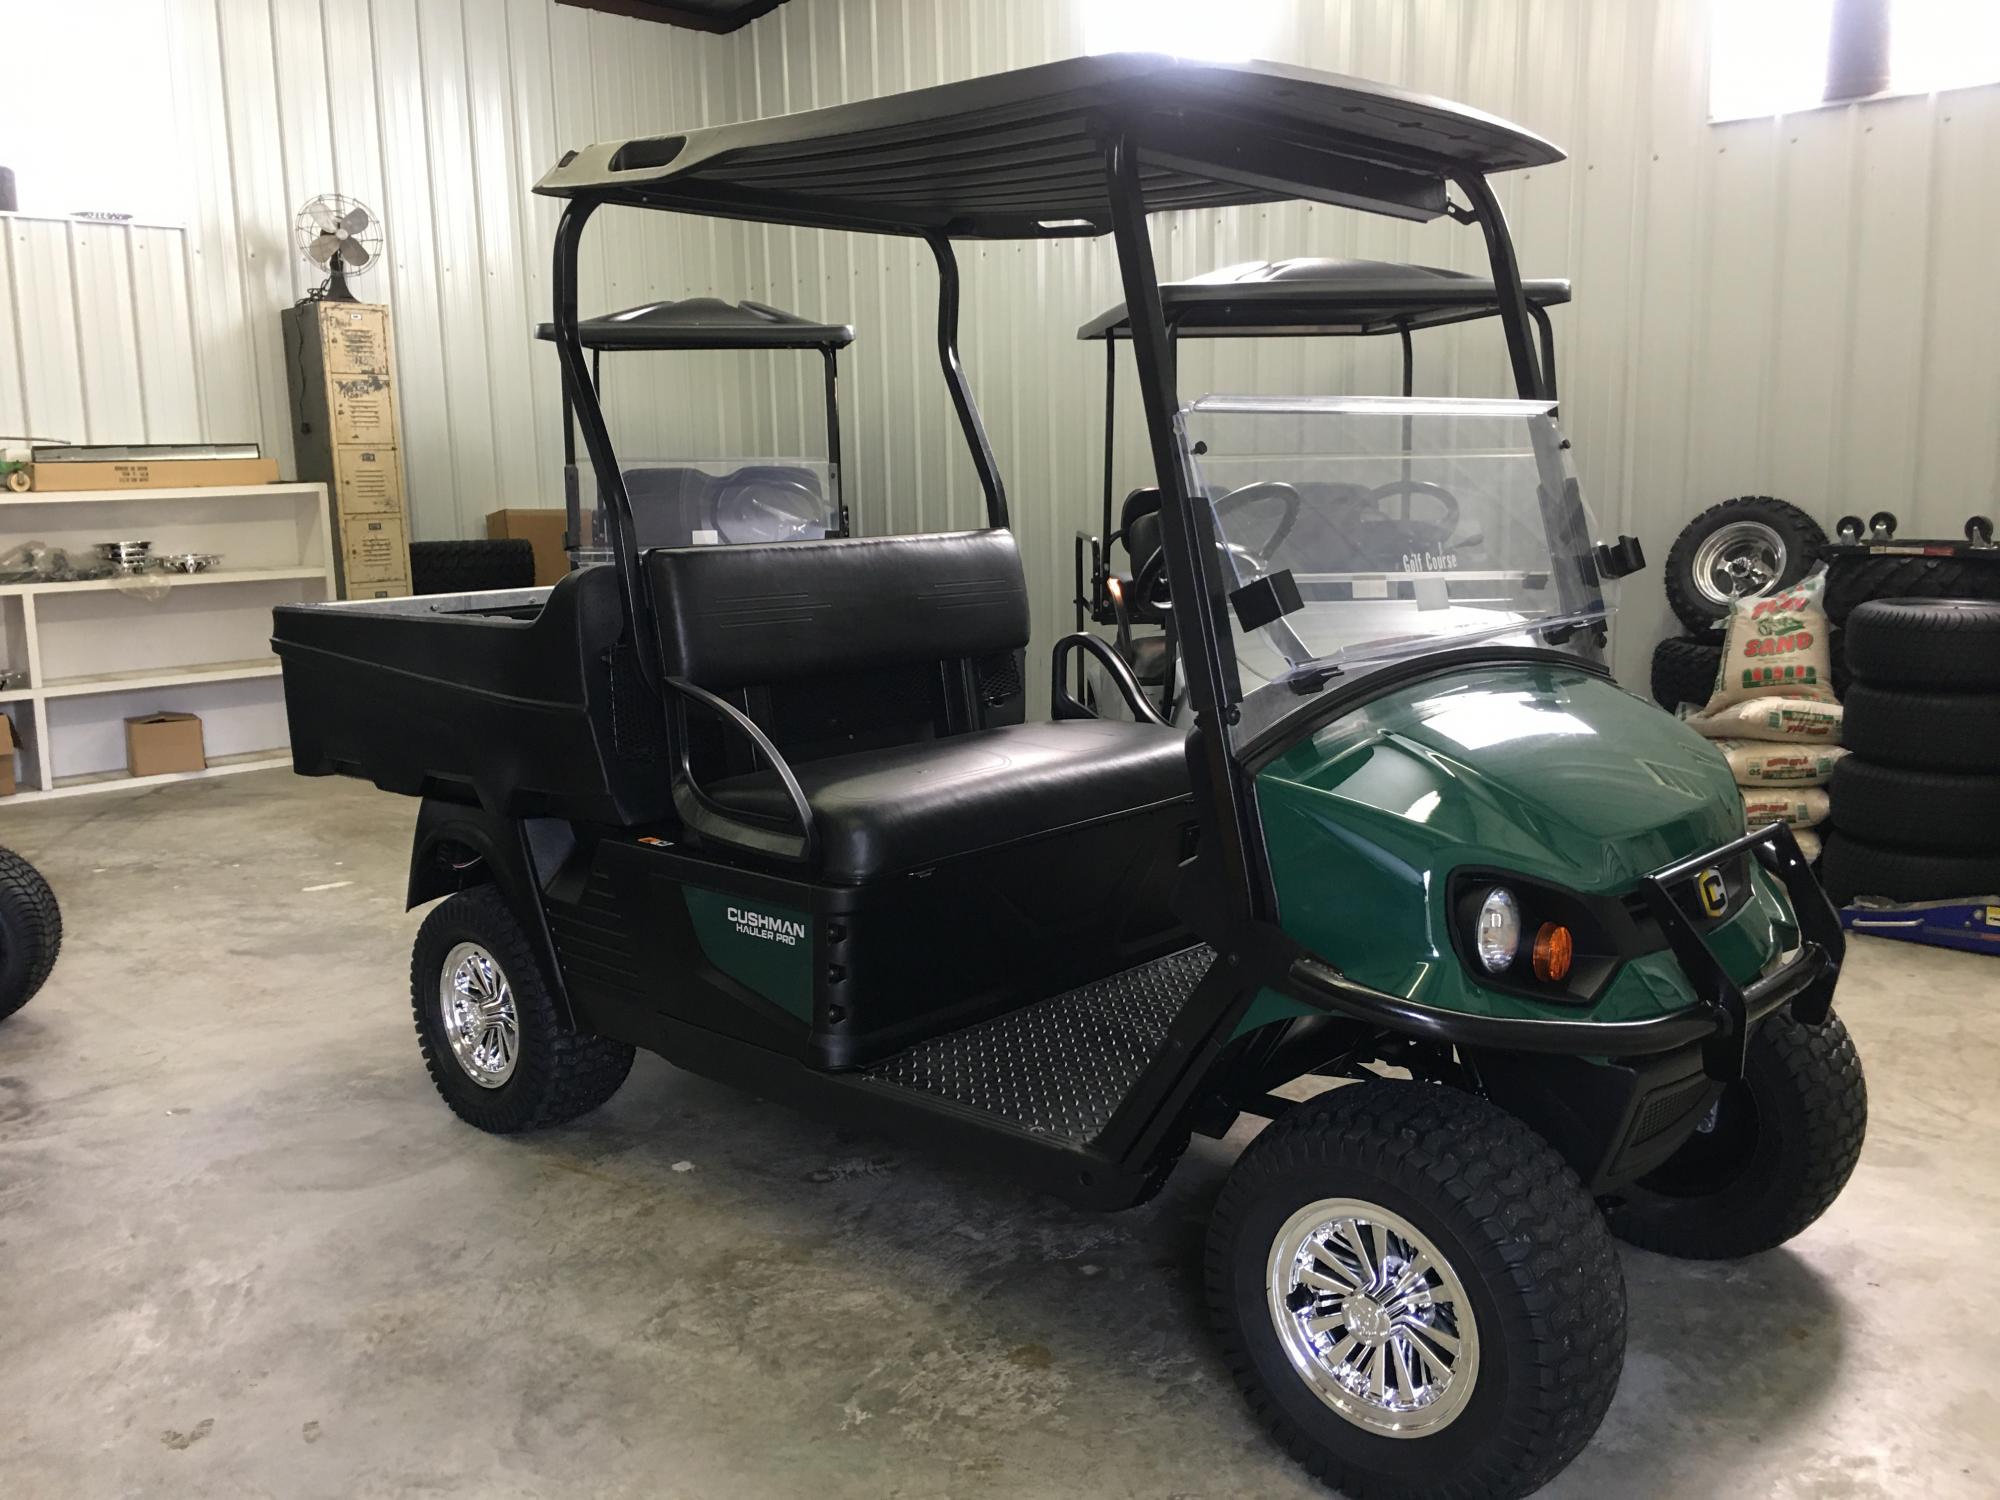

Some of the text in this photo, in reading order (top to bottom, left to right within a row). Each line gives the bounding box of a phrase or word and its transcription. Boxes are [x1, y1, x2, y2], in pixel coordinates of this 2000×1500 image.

[1402, 551, 1457, 573] Golf Course
[1744, 631, 1814, 657] SAND
[727, 907, 805, 938] CUSHMAN
[736, 923, 796, 946] HAULER PRO
